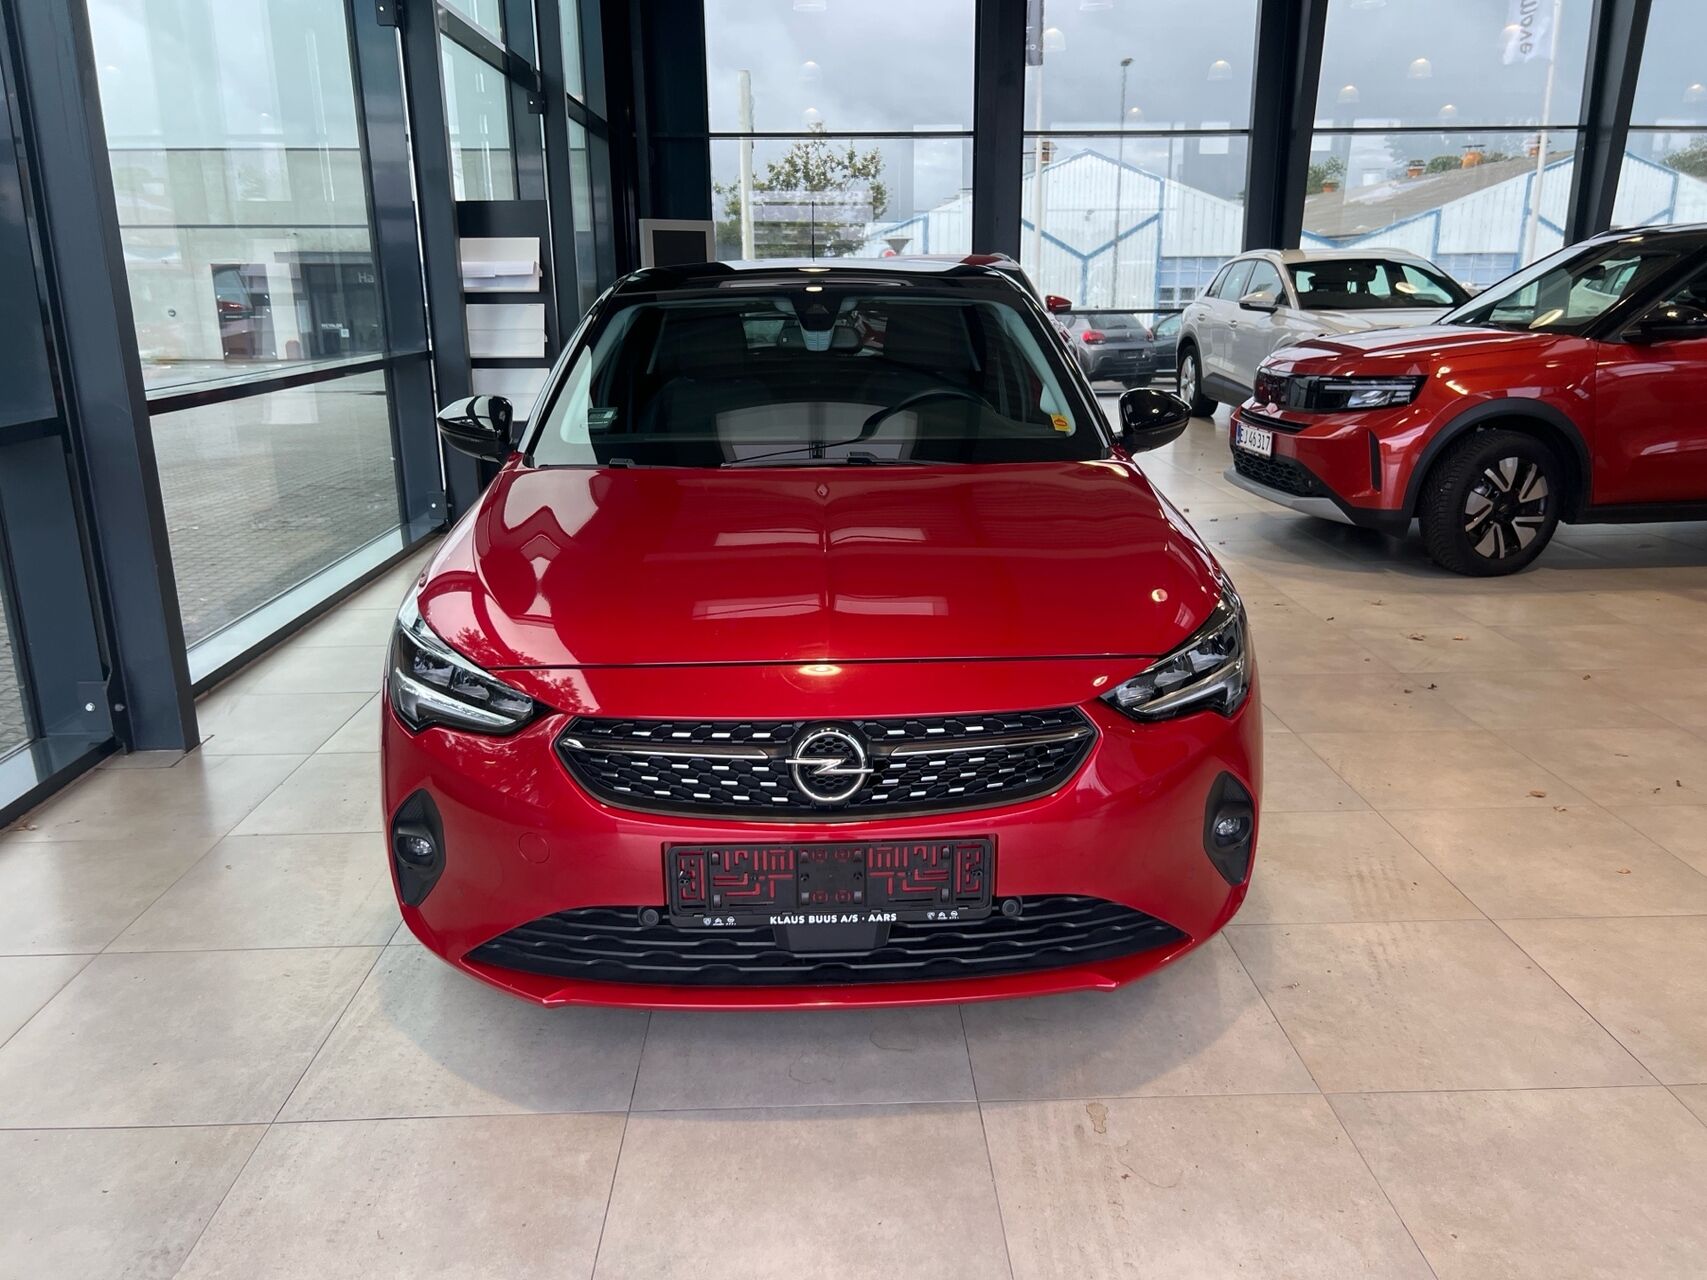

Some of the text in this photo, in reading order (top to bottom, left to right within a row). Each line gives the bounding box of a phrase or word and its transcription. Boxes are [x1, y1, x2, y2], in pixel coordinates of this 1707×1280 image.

[770, 915, 805, 925] KLAUS
[808, 914, 837, 924] BUUS
[840, 914, 859, 924] A/S
[868, 913, 897, 922] AARS
